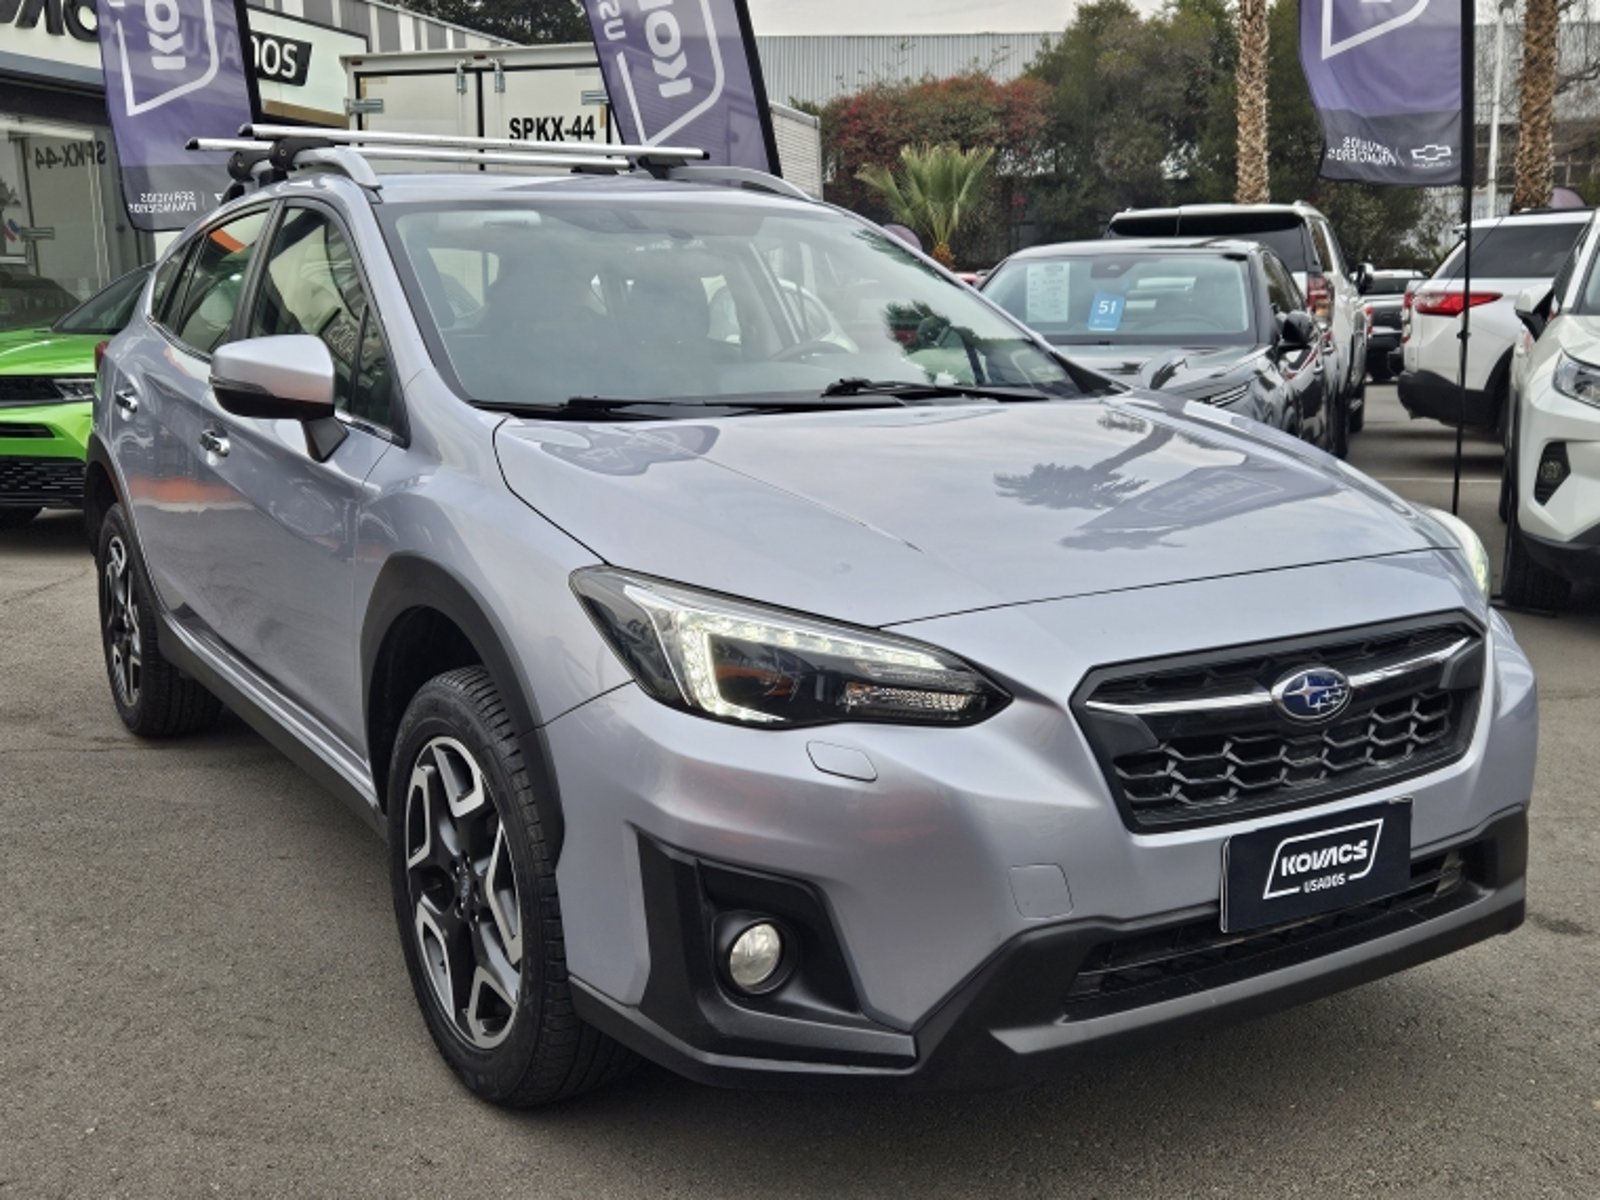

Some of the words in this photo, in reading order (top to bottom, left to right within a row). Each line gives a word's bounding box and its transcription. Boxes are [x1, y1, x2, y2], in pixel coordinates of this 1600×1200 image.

[509, 115, 596, 141] SPKX-44
[1098, 300, 1117, 314] 51
[1281, 839, 1368, 876] KOVACS
[1303, 873, 1346, 893] USADOS
